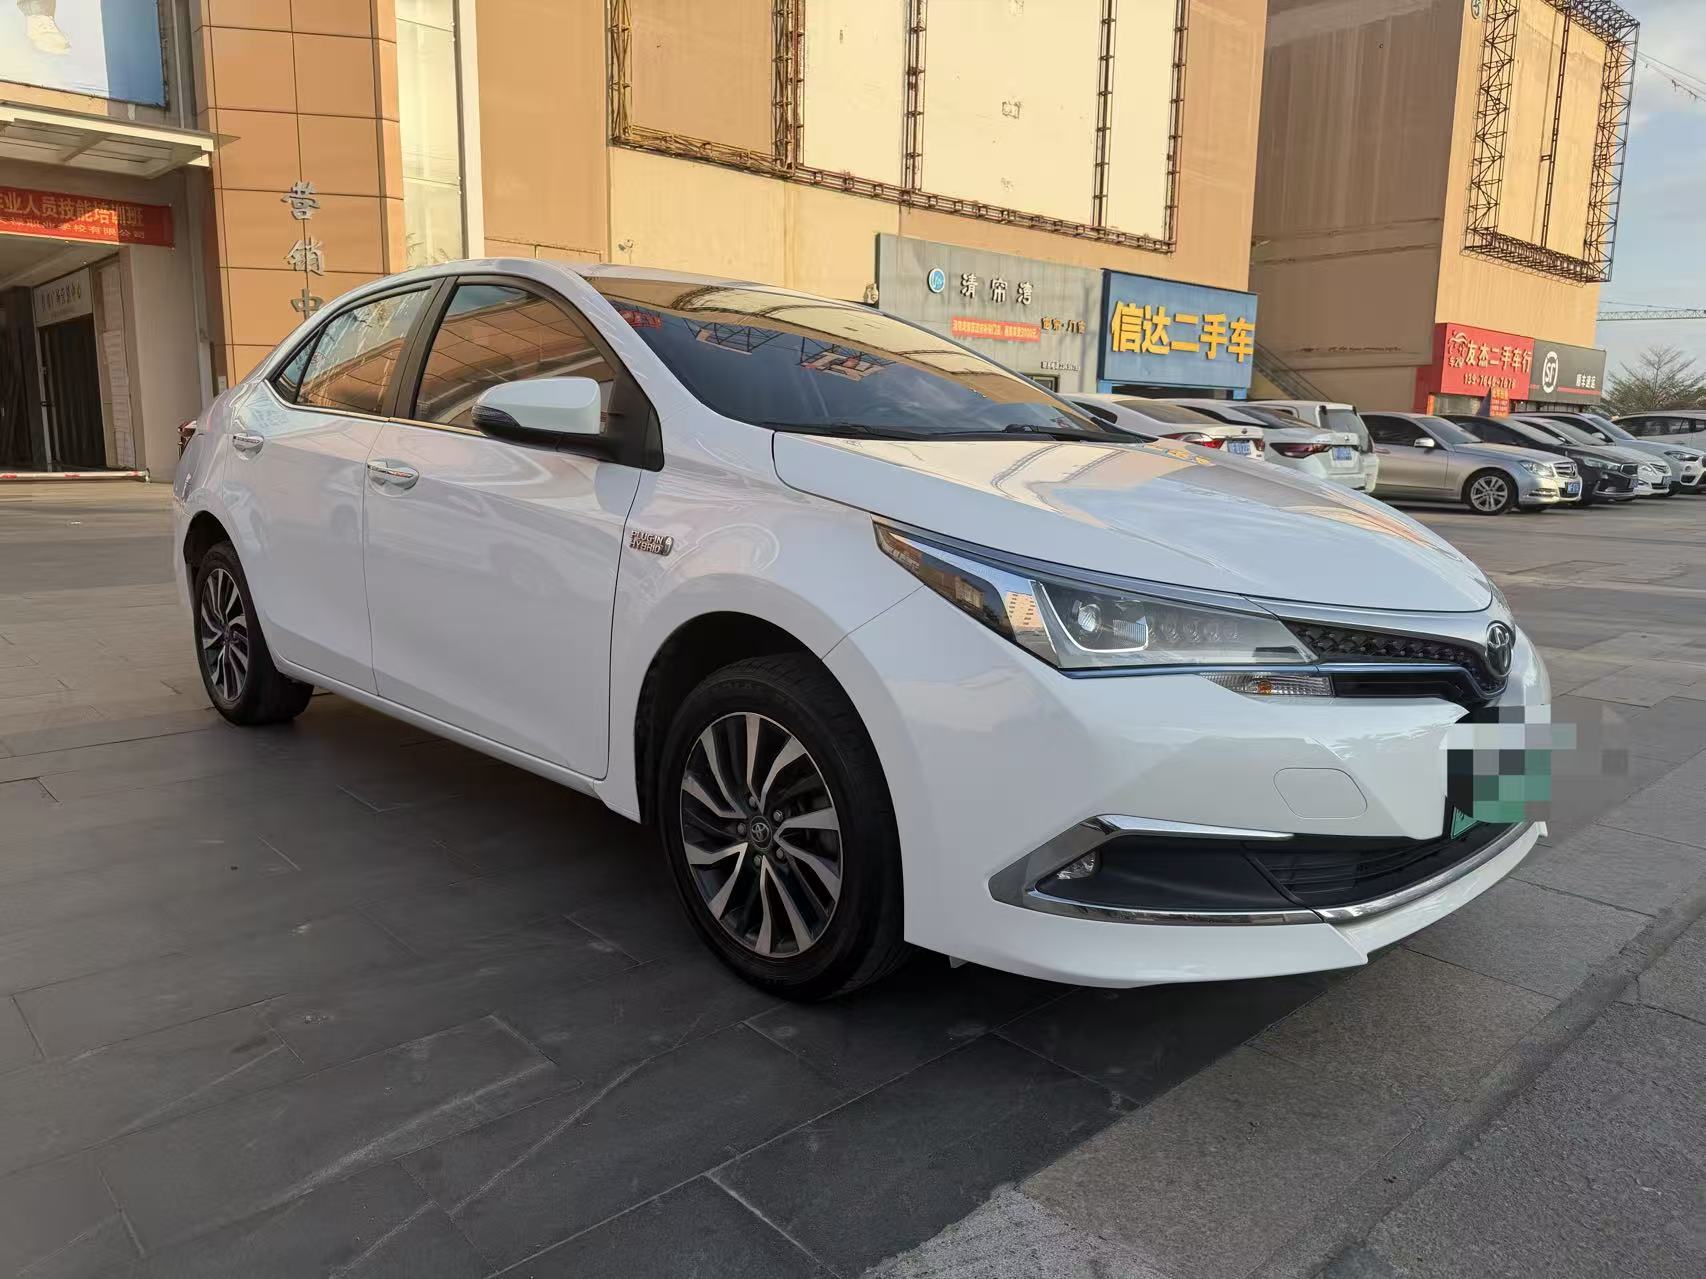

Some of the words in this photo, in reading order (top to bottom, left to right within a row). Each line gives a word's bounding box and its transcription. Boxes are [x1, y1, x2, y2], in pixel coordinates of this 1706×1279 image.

[0, 191, 145, 226] 业人员技能培训班
[1111, 300, 1256, 363] 信达二手车
[1466, 339, 1532, 373] 友杰二手车行
